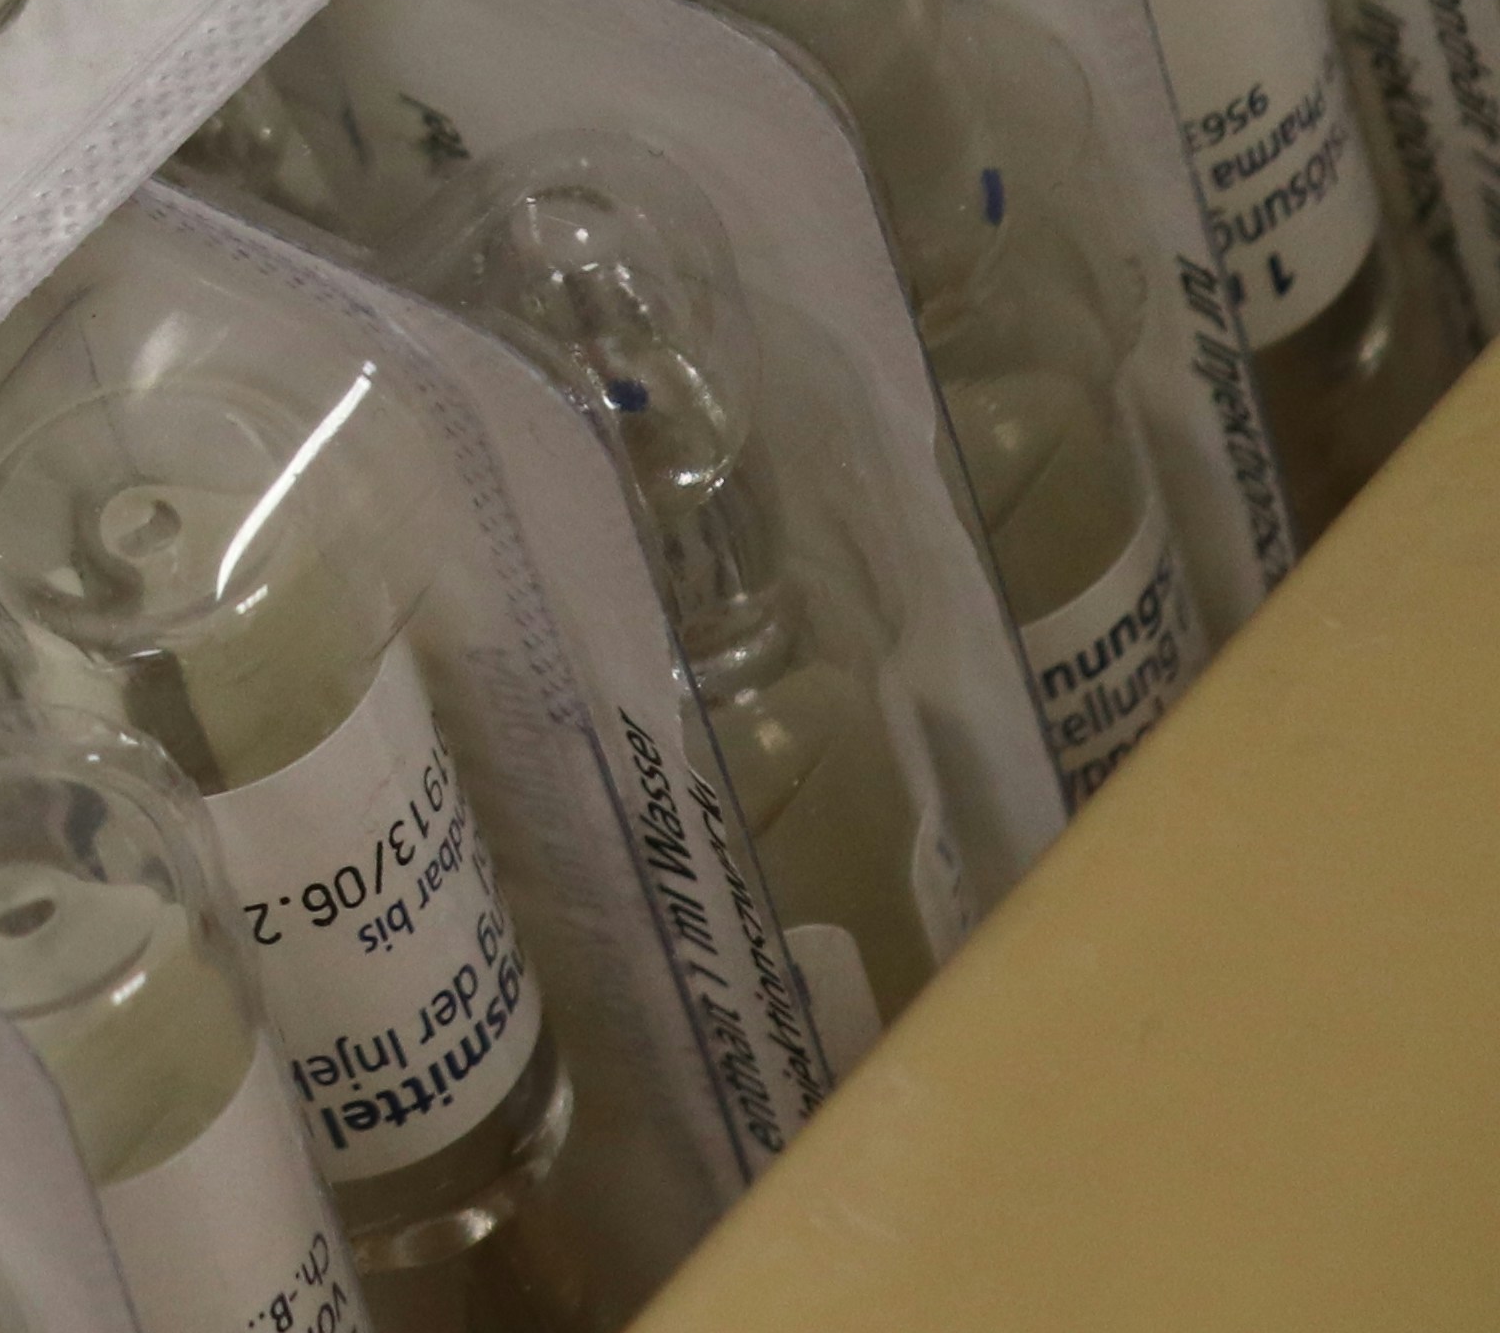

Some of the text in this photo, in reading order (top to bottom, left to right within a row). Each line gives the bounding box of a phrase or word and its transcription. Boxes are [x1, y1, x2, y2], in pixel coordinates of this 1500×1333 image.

[616, 705, 700, 881] Wasser
[356, 902, 416, 957] bis
[417, 965, 482, 1048] der
